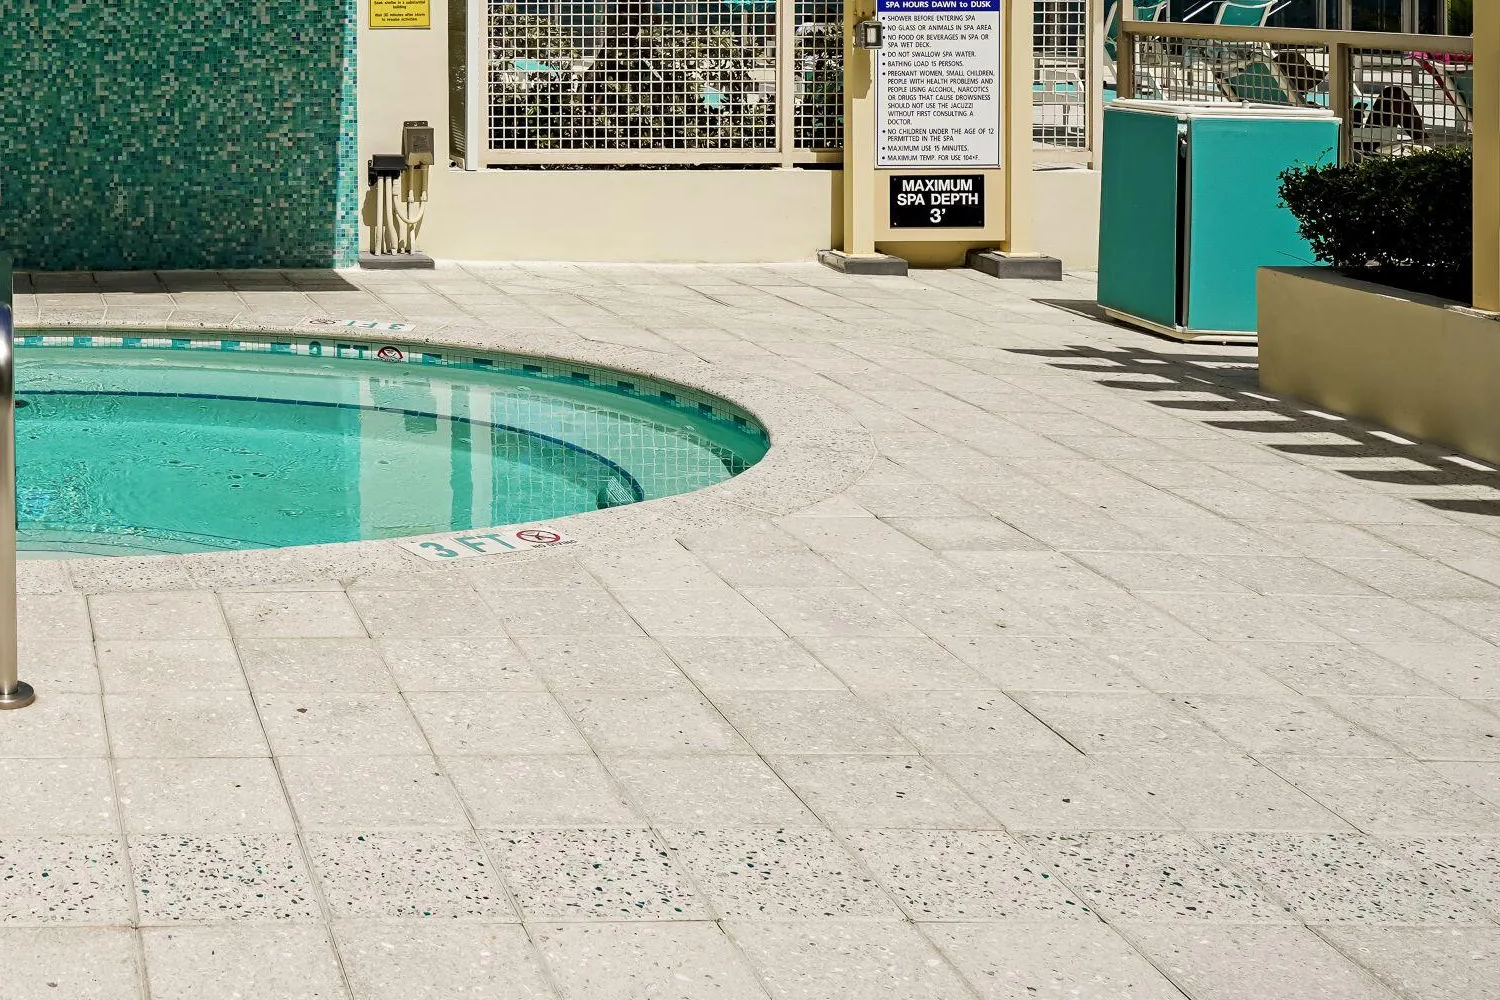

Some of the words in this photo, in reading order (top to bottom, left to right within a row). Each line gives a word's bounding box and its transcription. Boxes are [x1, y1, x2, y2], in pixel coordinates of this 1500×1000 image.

[902, 179, 973, 191] MAXIMUM
[897, 193, 925, 206] SPA
[931, 193, 978, 205] DEPTH
[929, 208, 946, 223] 3'
[419, 541, 459, 558] 3
[455, 533, 516, 554] FT
